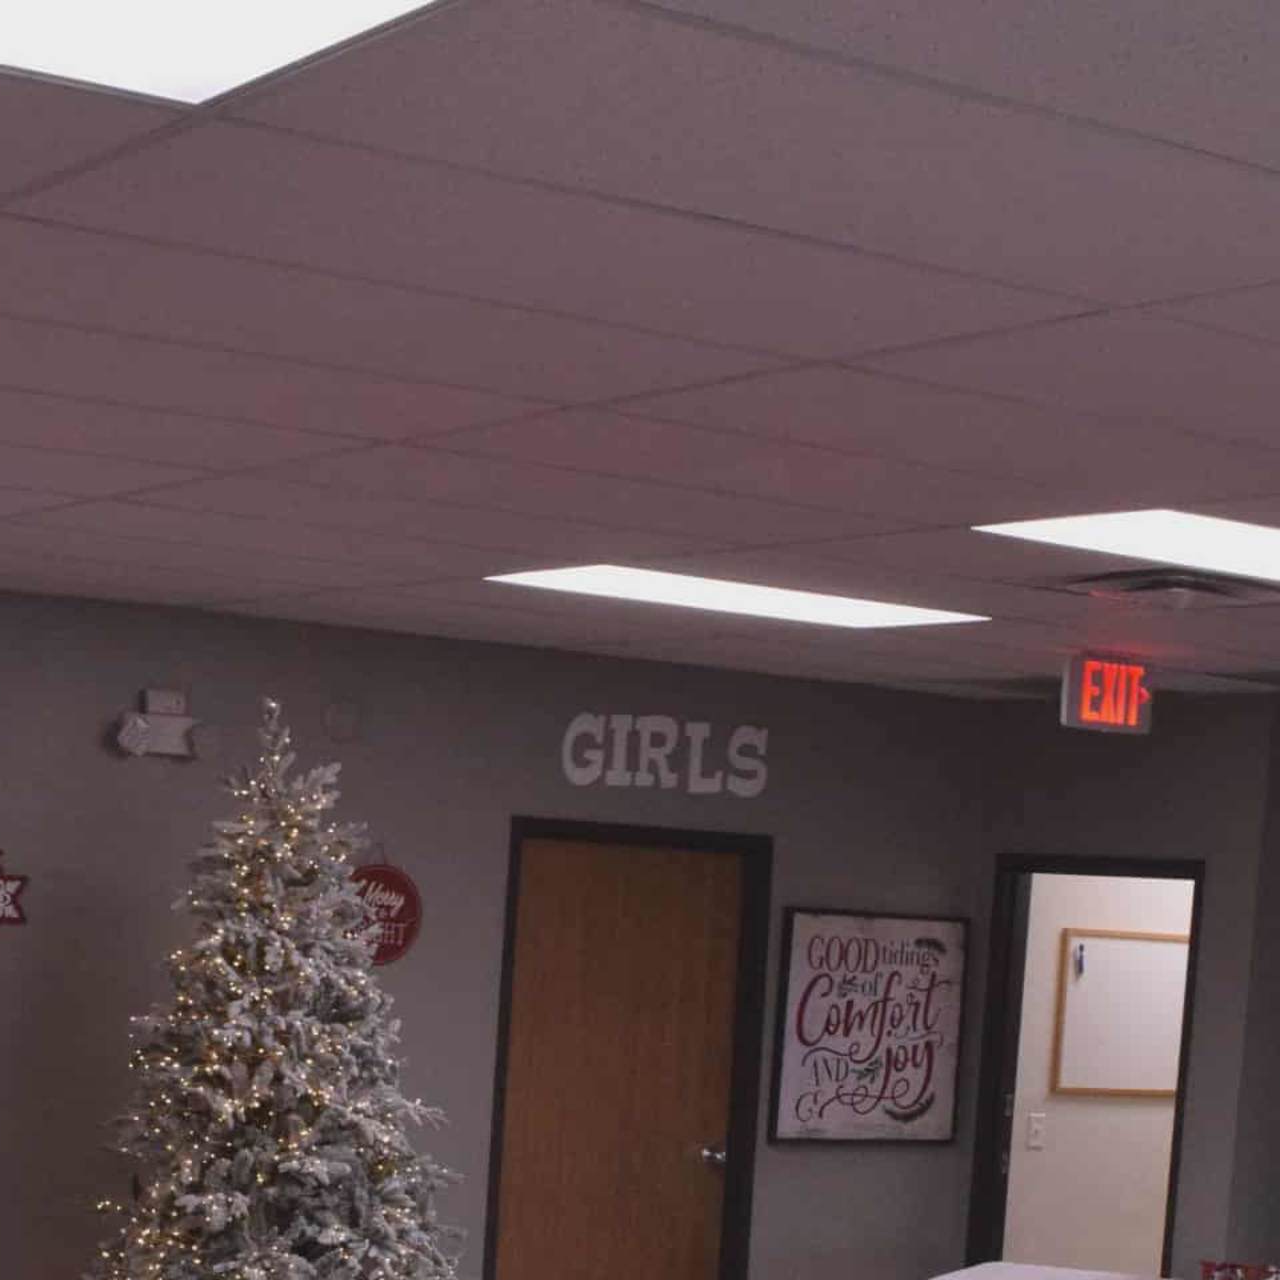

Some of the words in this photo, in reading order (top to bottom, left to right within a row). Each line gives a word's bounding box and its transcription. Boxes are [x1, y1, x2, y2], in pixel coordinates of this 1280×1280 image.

[1081, 660, 1145, 726] EXIT
[562, 712, 769, 797] GIRLS
[807, 934, 880, 973] GOOD
[881, 941, 941, 975] tidings
[860, 972, 884, 997] of
[796, 970, 948, 1062] Comfort
